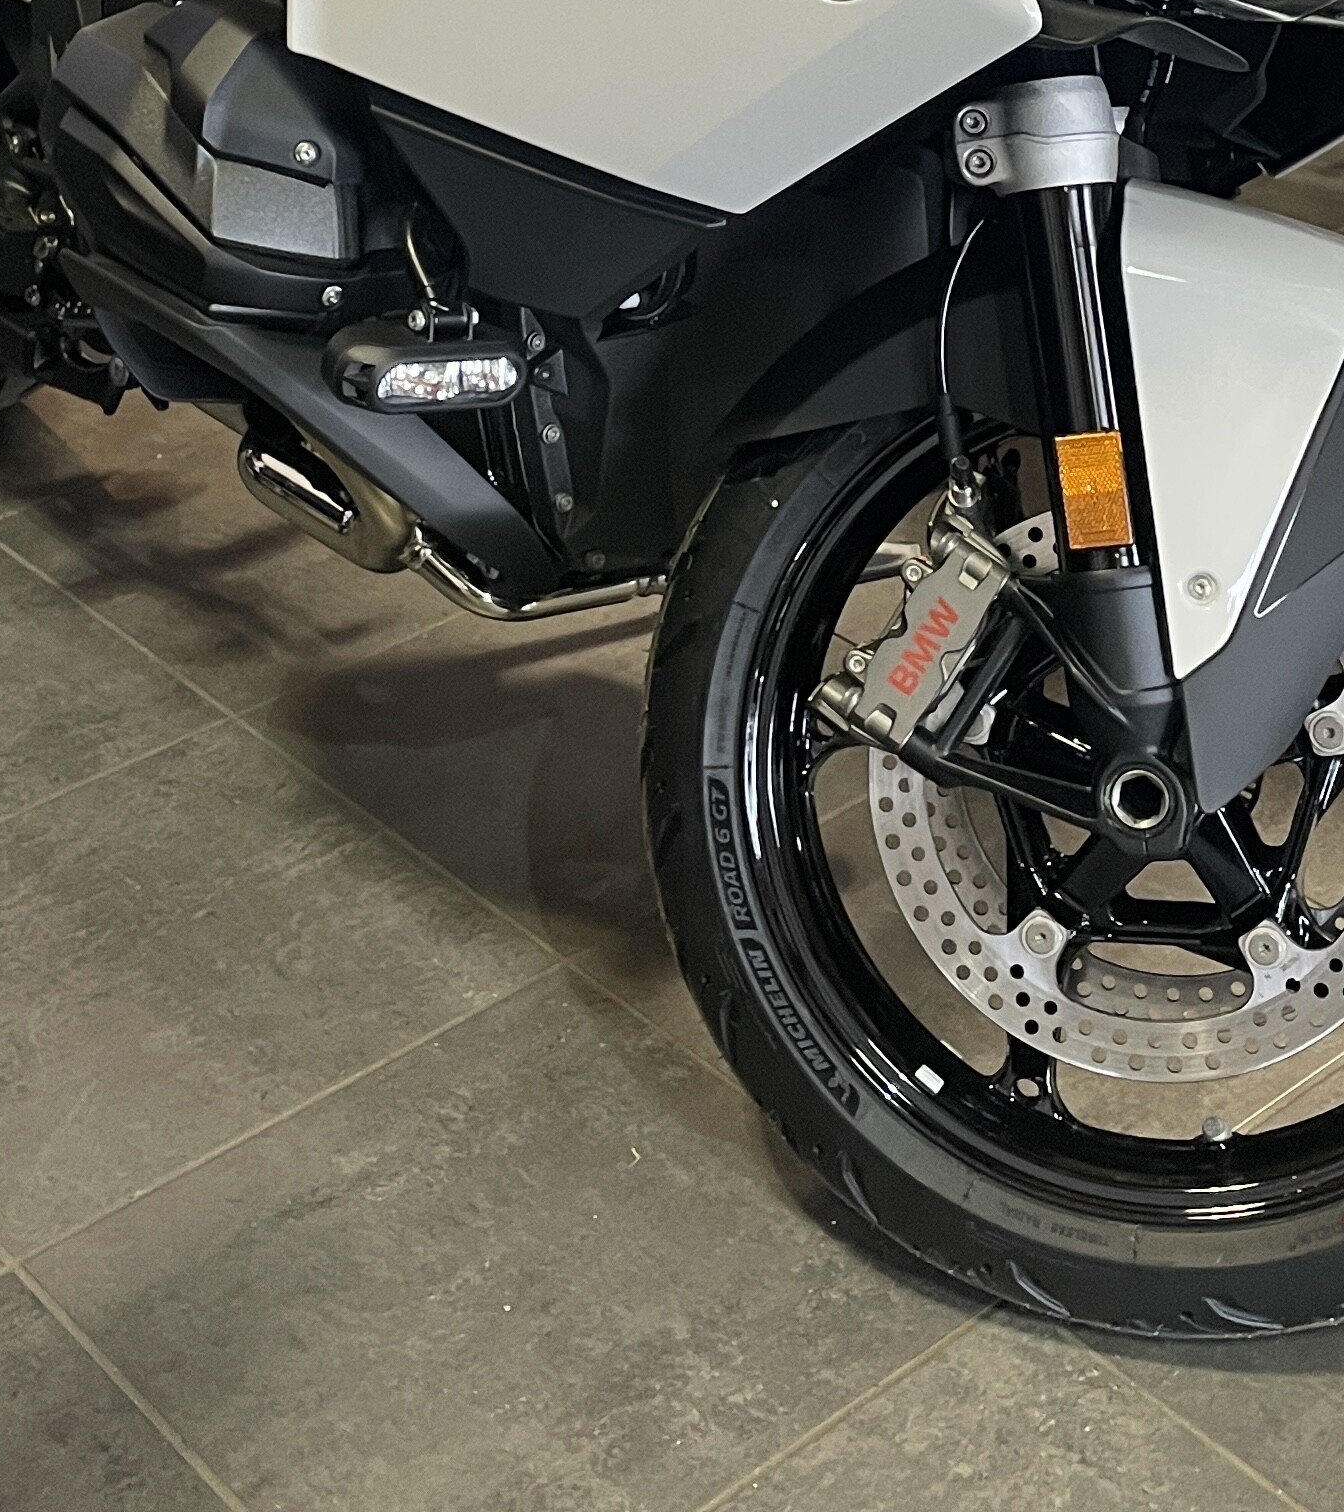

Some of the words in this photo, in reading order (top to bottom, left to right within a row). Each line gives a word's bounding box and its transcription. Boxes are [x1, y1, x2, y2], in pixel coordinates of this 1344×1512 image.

[886, 595, 960, 697] BMW
[711, 785, 728, 821] GT
[715, 827, 731, 844] 6
[719, 851, 752, 922] ROAD
[747, 949, 832, 1072] MICHELIN
